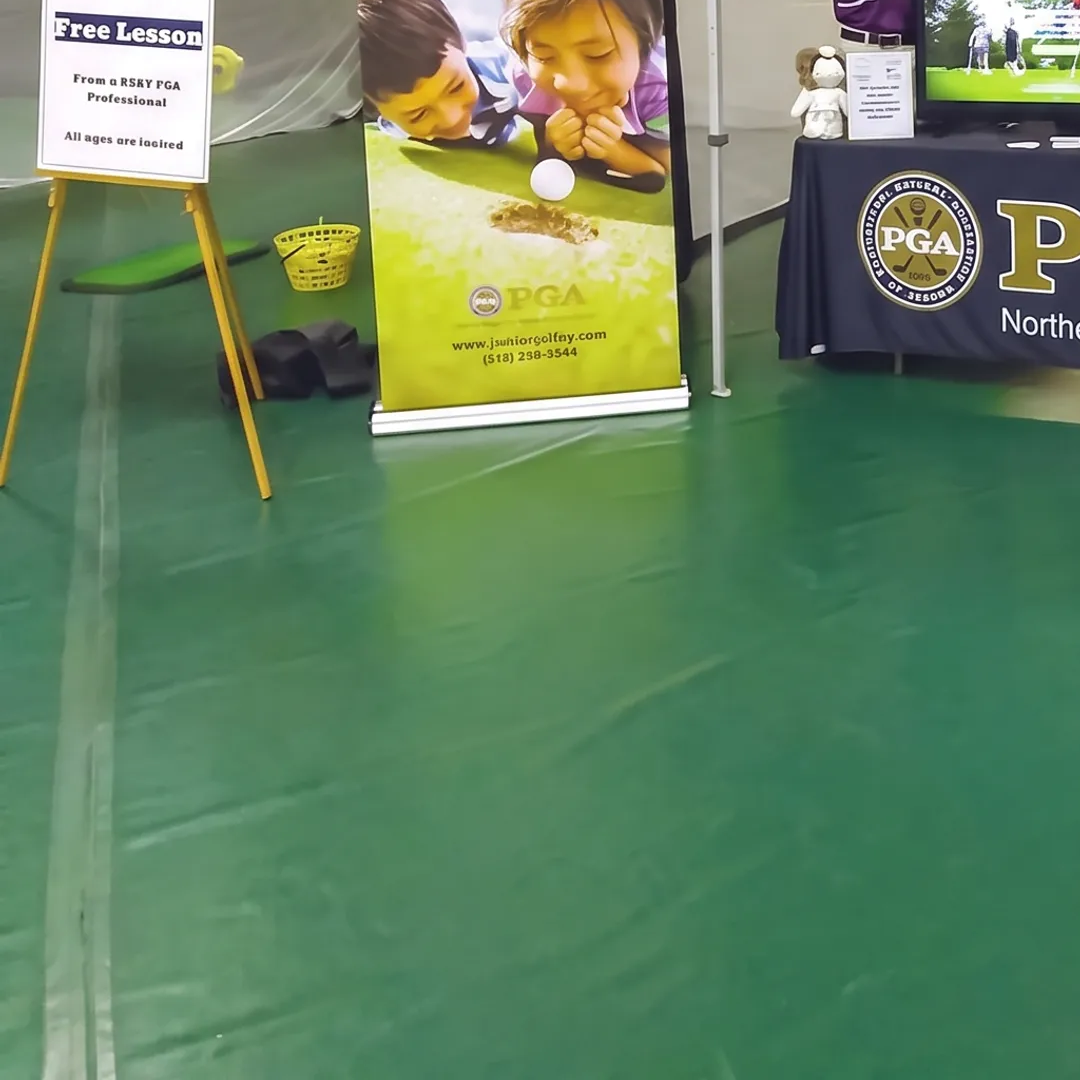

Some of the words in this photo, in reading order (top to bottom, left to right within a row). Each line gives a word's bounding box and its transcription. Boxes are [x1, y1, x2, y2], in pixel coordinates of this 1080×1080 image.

[54, 17, 110, 41] Free
[116, 22, 203, 46] Lesson
[73, 74, 106, 86] From
[109, 78, 117, 86] a
[87, 92, 167, 107] Professional
[64, 131, 81, 142] All
[84, 134, 113, 145] ages
[117, 137, 136, 146] are
[880, 226, 960, 256] PGA
[507, 283, 586, 311] PGA
